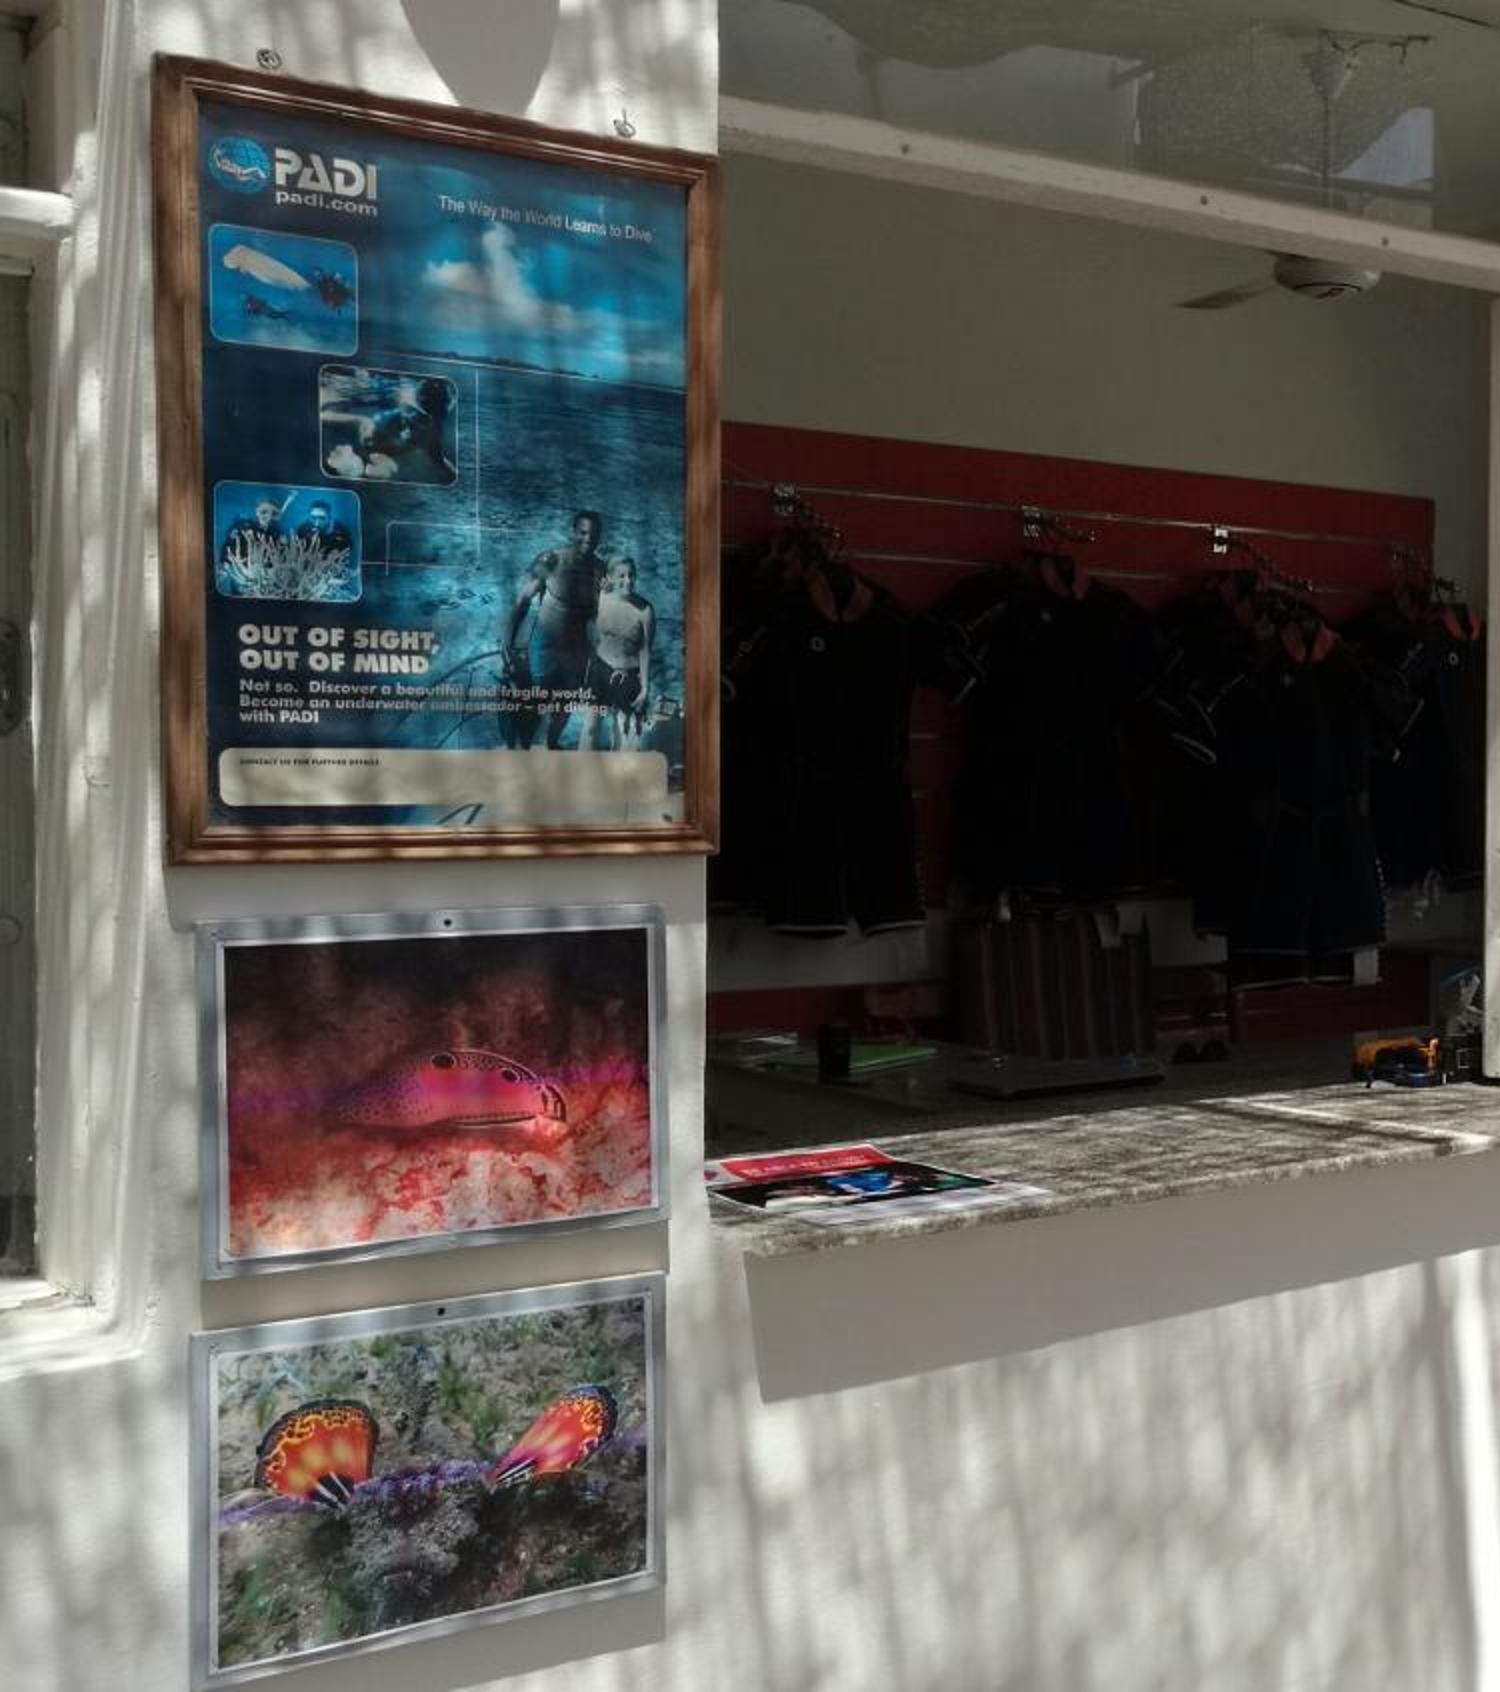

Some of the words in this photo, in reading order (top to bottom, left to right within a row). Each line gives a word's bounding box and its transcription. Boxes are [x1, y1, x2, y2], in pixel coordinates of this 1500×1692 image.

[275, 147, 378, 201] PADI
[275, 190, 379, 217] padi.com
[439, 195, 465, 213] The
[468, 198, 498, 220] Way
[500, 206, 522, 223] the
[525, 208, 562, 228] World
[564, 215, 607, 237] Learns
[609, 224, 622, 238] to
[624, 224, 653, 243] Dive
[238, 623, 299, 646] OUT
[307, 626, 346, 648] OF
[352, 628, 440, 656] SIGHT,
[239, 649, 299, 672] OUT
[307, 650, 346, 673] OF
[353, 652, 430, 675] MIND
[239, 678, 272, 693] Not
[275, 682, 299, 694] so.
[308, 680, 378, 695] Discover
[381, 684, 392, 696] a
[396, 681, 466, 698] beautiful
[468, 686, 498, 698] and
[501, 685, 550, 701] fragile
[552, 687, 597, 701] world.
[239, 693, 305, 709] Become
[309, 698, 331, 710] an
[334, 696, 426, 711] underwater
[537, 701, 562, 715] get
[563, 701, 609, 717] diving
[239, 709, 276, 724] with
[279, 709, 320, 724] PADI
